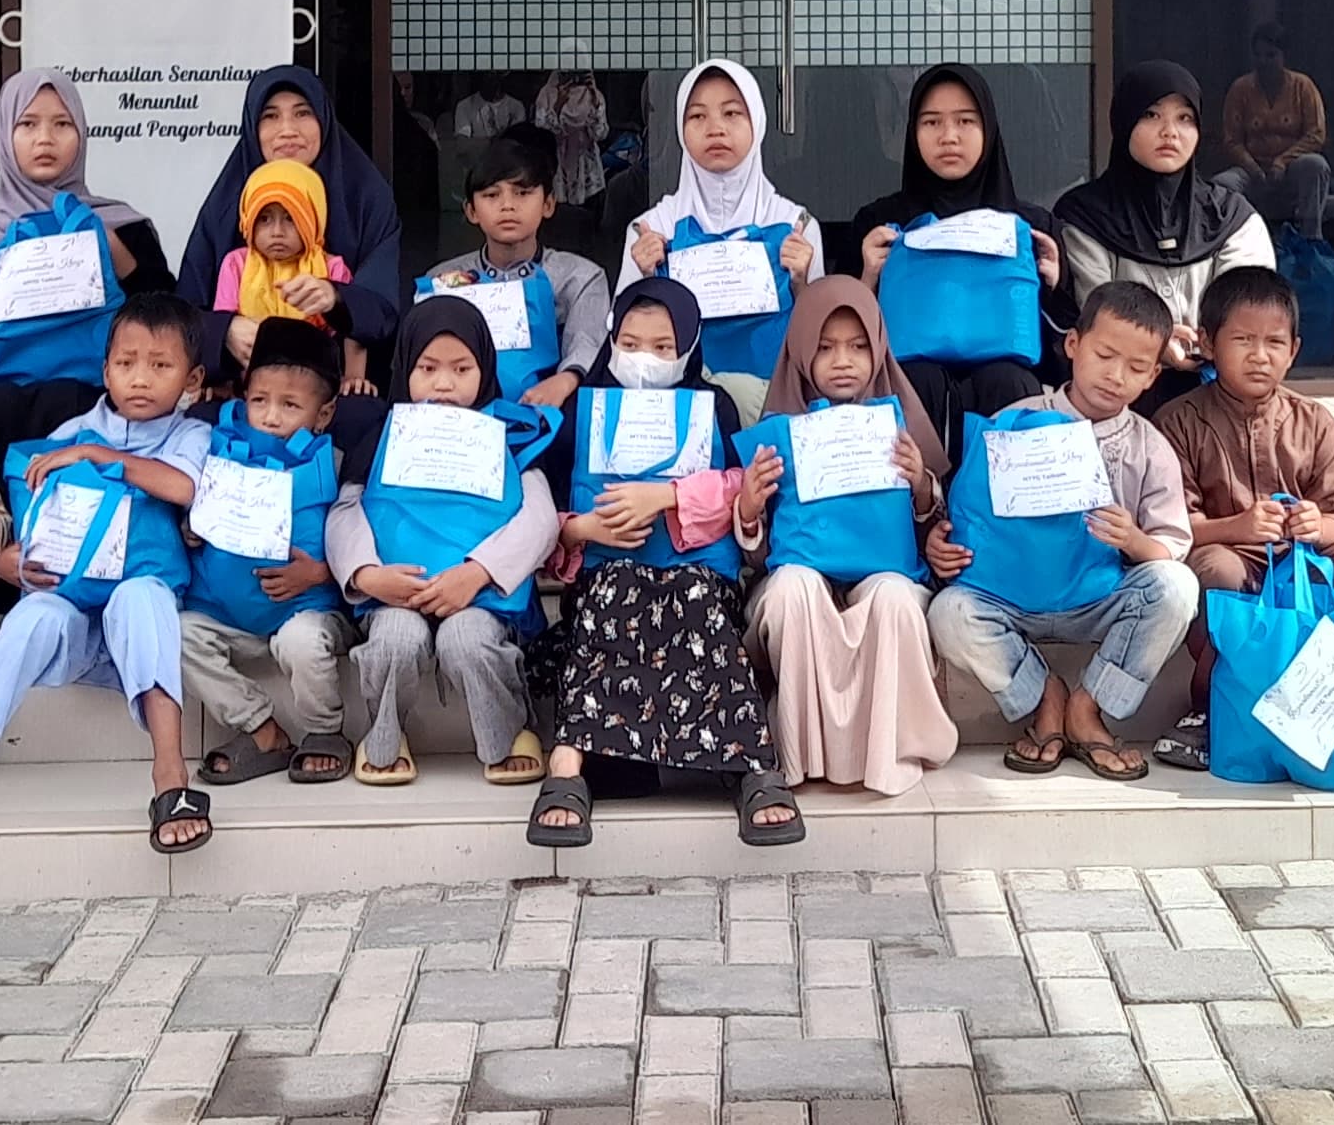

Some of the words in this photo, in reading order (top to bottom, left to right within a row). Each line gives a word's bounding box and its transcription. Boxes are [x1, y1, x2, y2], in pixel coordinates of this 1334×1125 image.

[54, 65, 164, 83] berhasilan
[168, 64, 259, 83] Senantias
[118, 92, 199, 111] Menuntut
